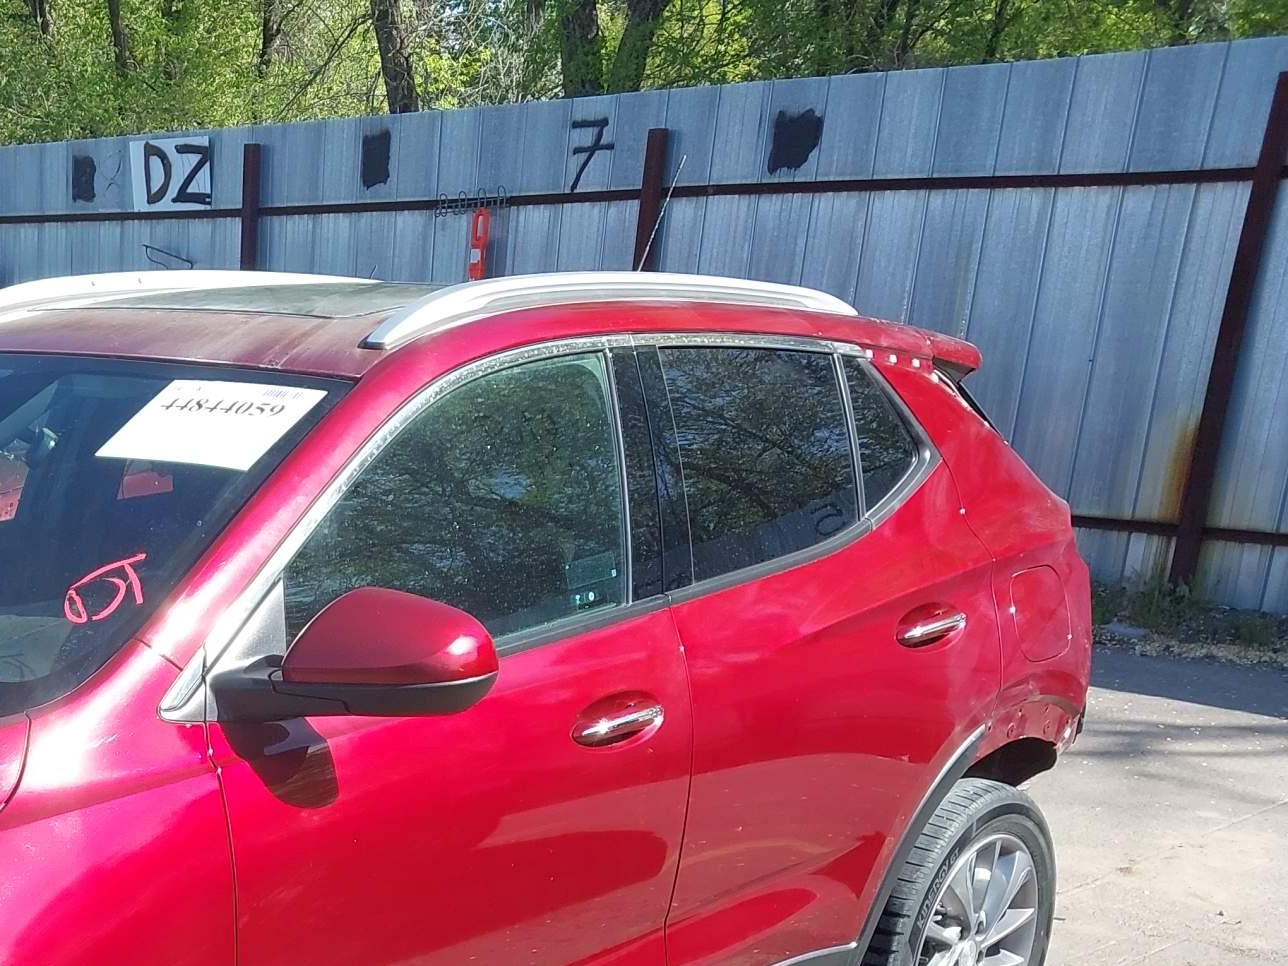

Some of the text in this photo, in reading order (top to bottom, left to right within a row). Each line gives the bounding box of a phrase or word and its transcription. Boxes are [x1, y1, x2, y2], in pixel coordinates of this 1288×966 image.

[143, 141, 212, 206] DZ
[570, 117, 615, 192] 7
[160, 397, 287, 417] 44844059
